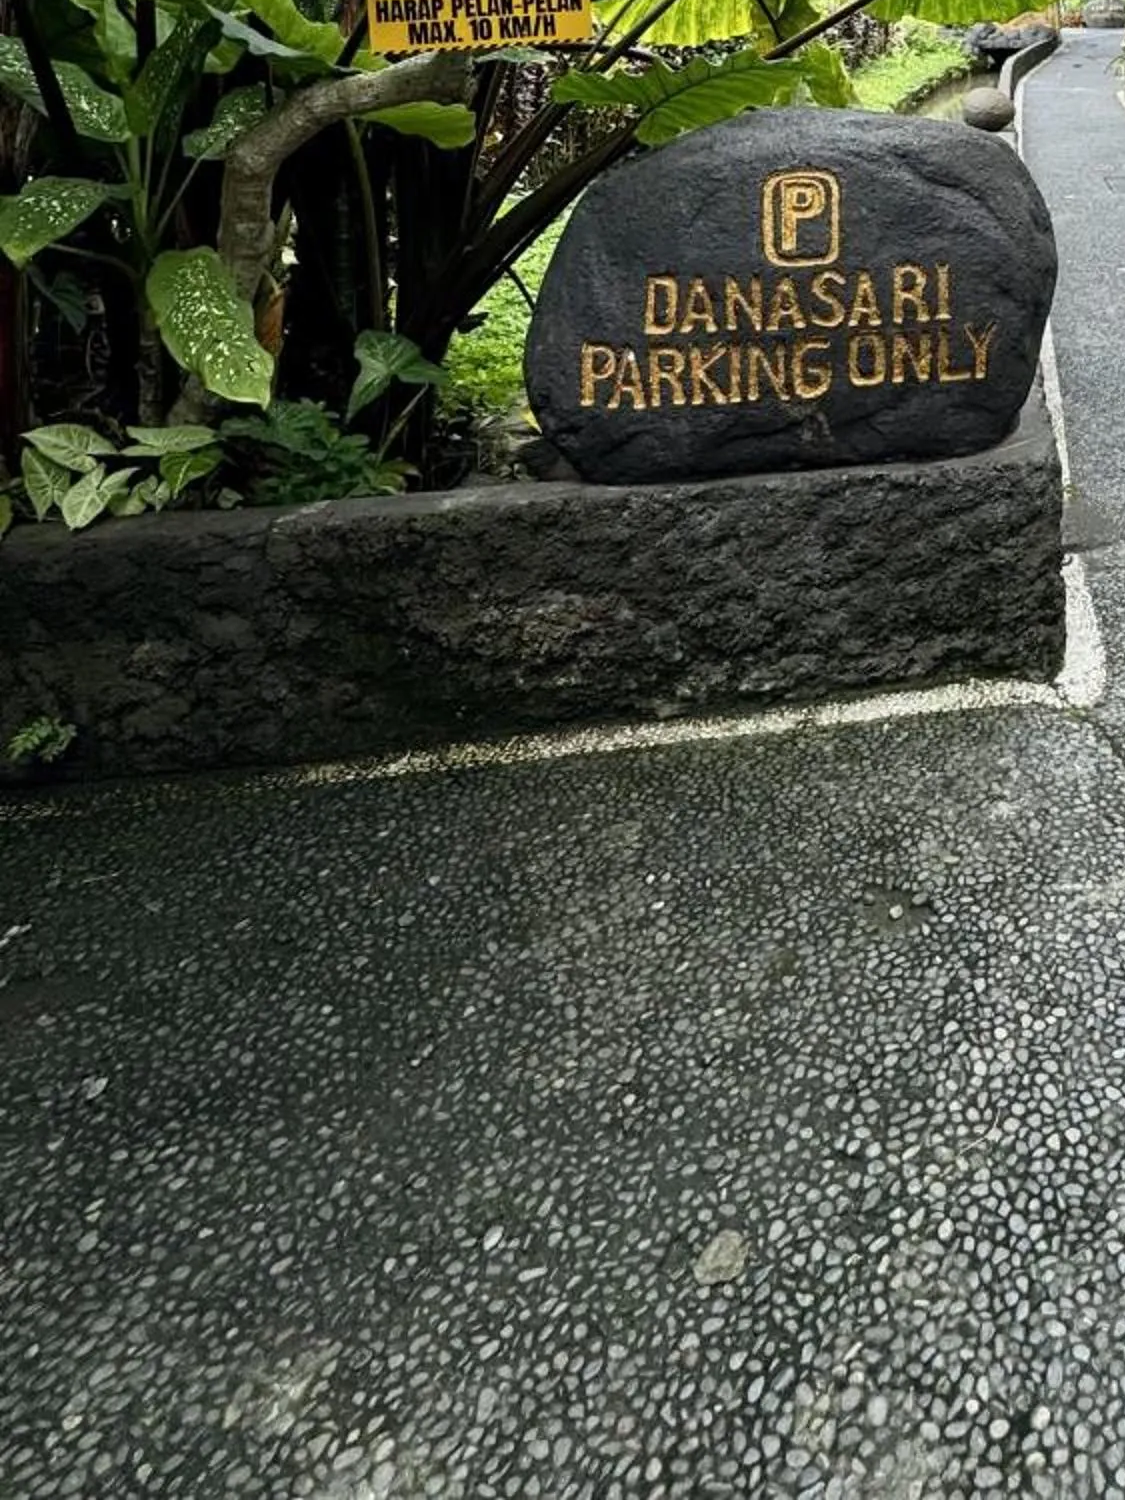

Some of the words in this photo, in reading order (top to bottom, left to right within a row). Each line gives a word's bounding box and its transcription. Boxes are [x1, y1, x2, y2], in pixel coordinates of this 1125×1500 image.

[407, 19, 463, 45] MAX.
[470, 18, 493, 41] 10
[499, 14, 557, 39] KM/H
[779, 178, 828, 253] P
[579, 336, 834, 411] PARKING
[846, 321, 997, 388] ONLY
